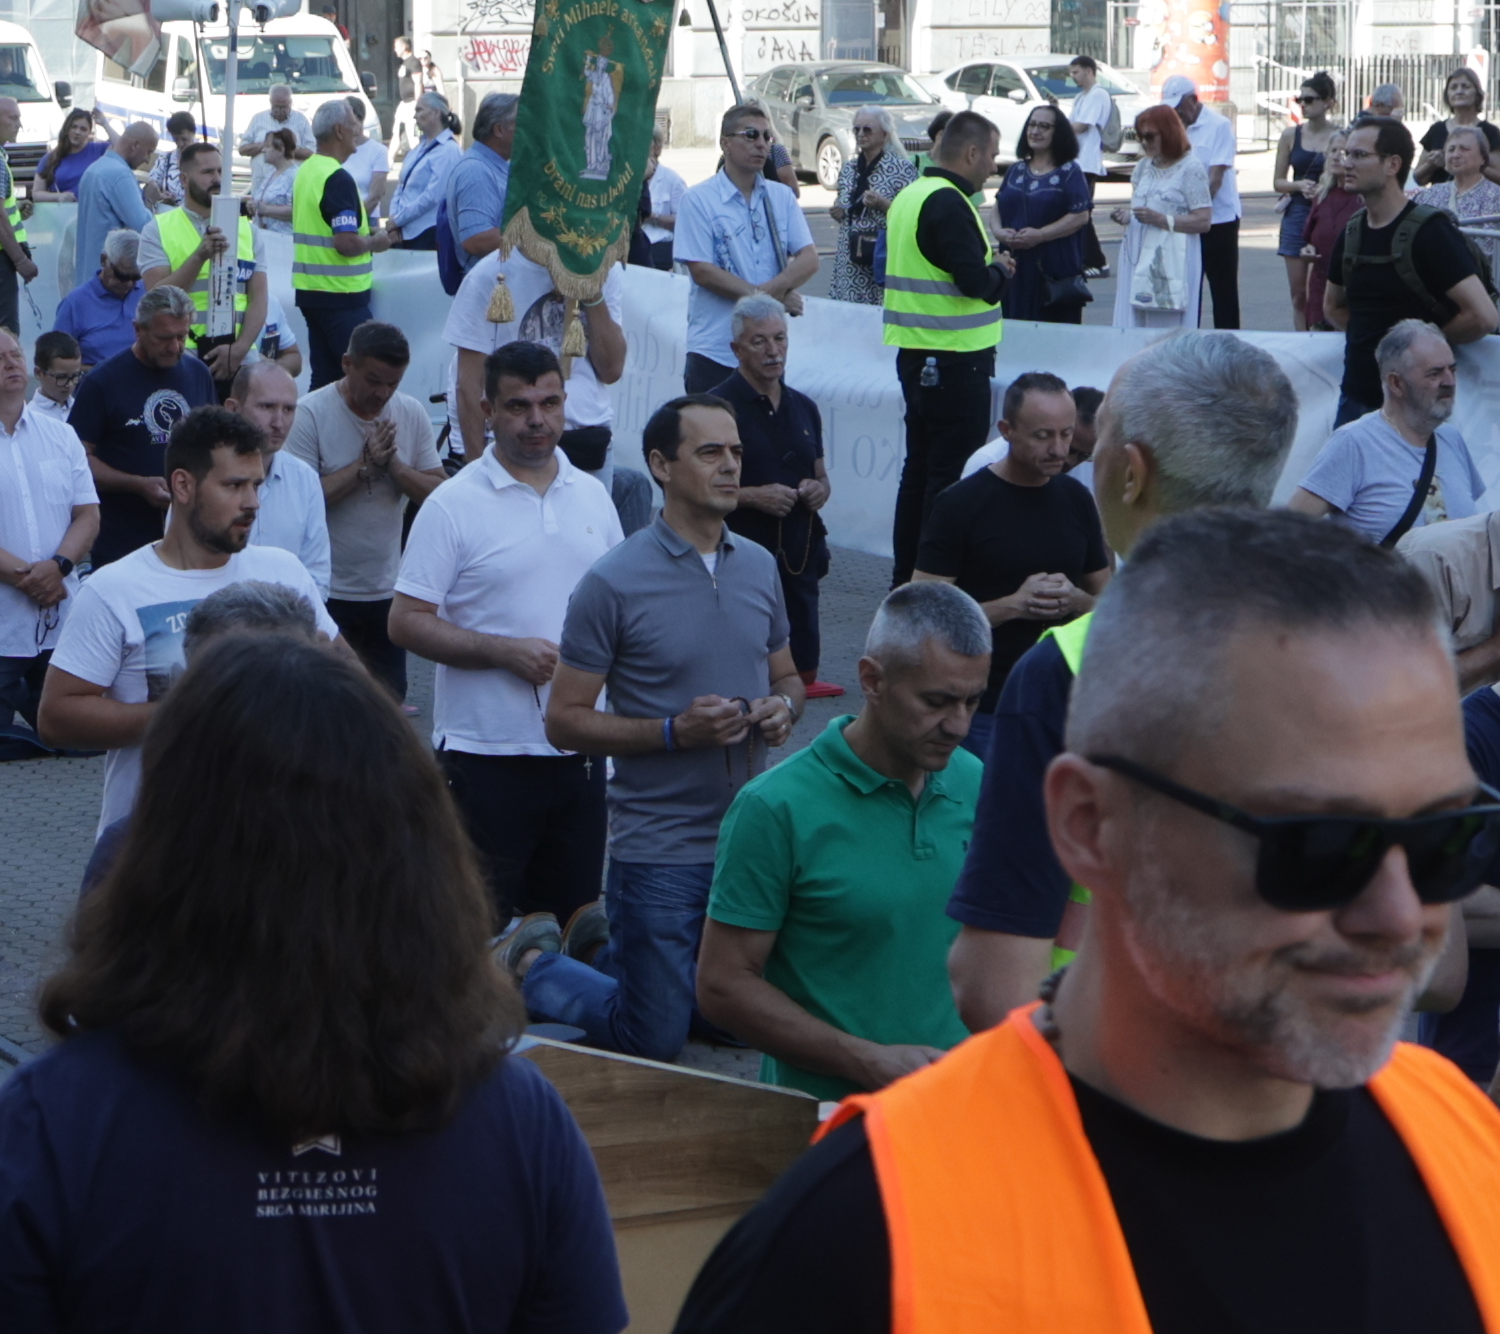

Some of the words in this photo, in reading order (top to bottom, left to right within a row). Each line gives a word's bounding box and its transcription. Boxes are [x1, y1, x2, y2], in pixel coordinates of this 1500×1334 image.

[575, 191, 599, 209] nas
[599, 193, 608, 208] u
[257, 1167, 377, 1184] VITEZOVI
[255, 1203, 295, 1218] SRCA
[298, 1201, 377, 1217] MARIJINA
